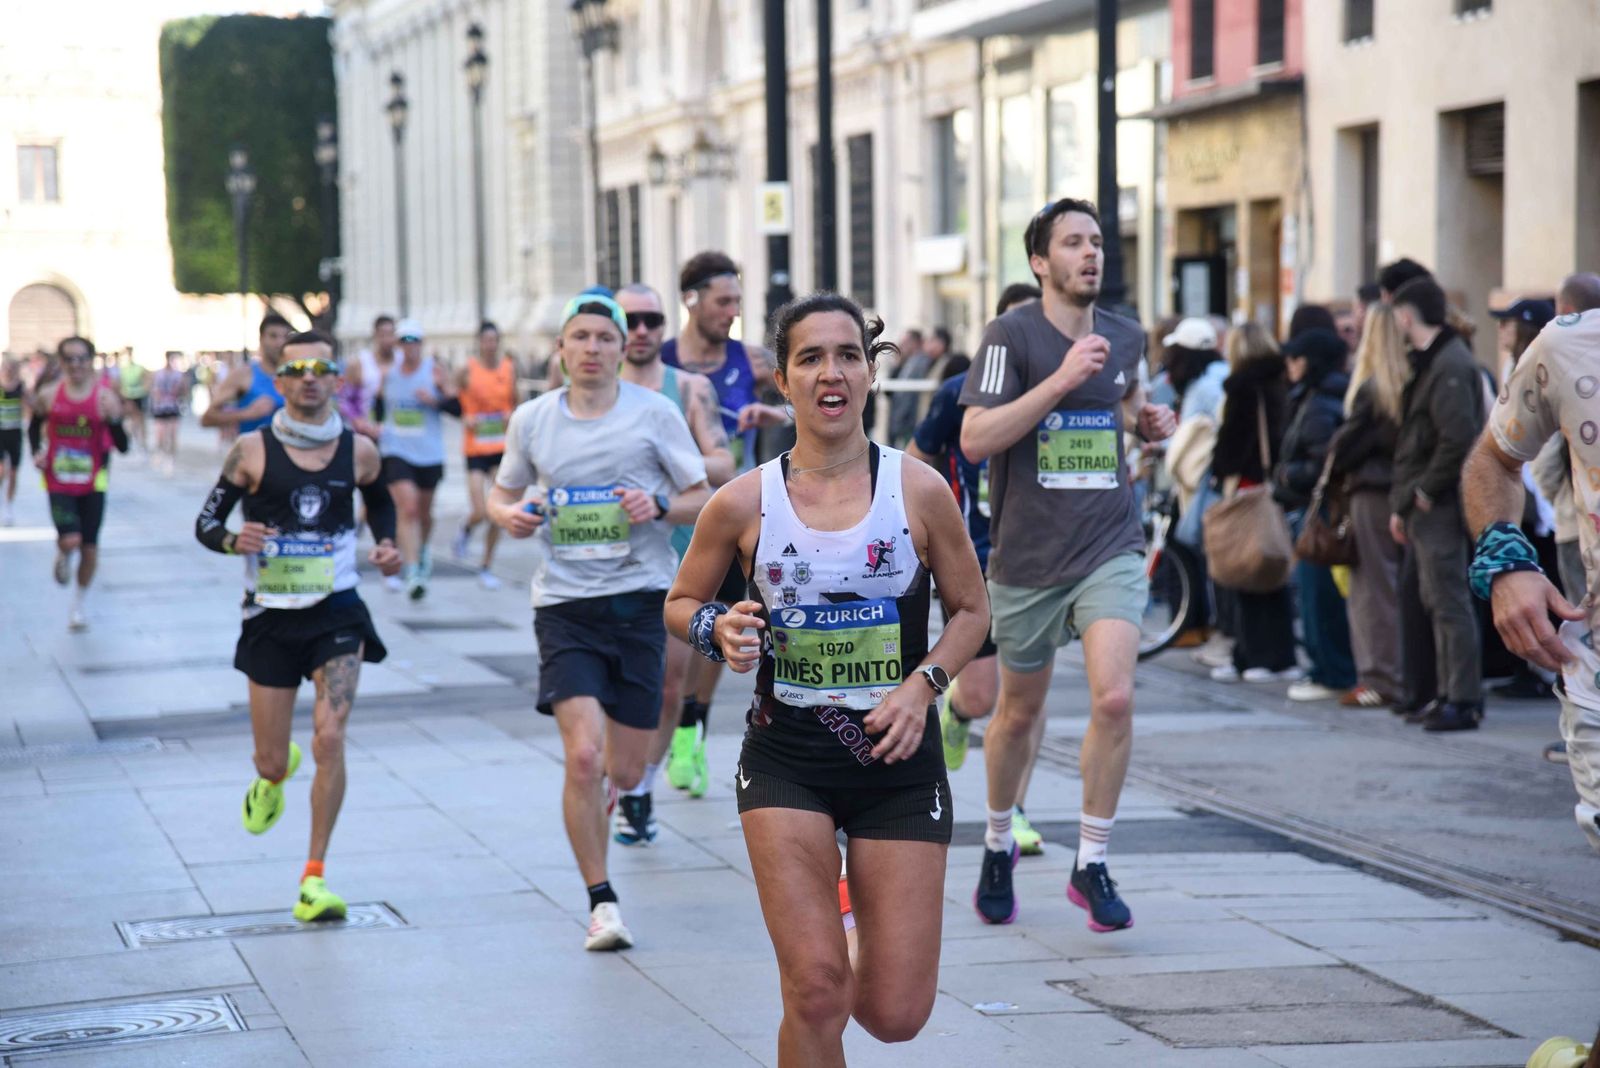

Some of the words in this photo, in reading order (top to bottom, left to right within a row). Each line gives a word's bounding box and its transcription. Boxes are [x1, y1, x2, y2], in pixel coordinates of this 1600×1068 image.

[1068, 415, 1111, 427] ZURICH
[1039, 457, 1053, 470] G.
[1058, 456, 1116, 470] ESTRADA
[558, 526, 620, 542] THOMAS
[814, 604, 884, 624] ZURICH
[817, 641, 855, 657] 1970
[776, 657, 823, 685] INÊS
[832, 659, 901, 684] PINTO
